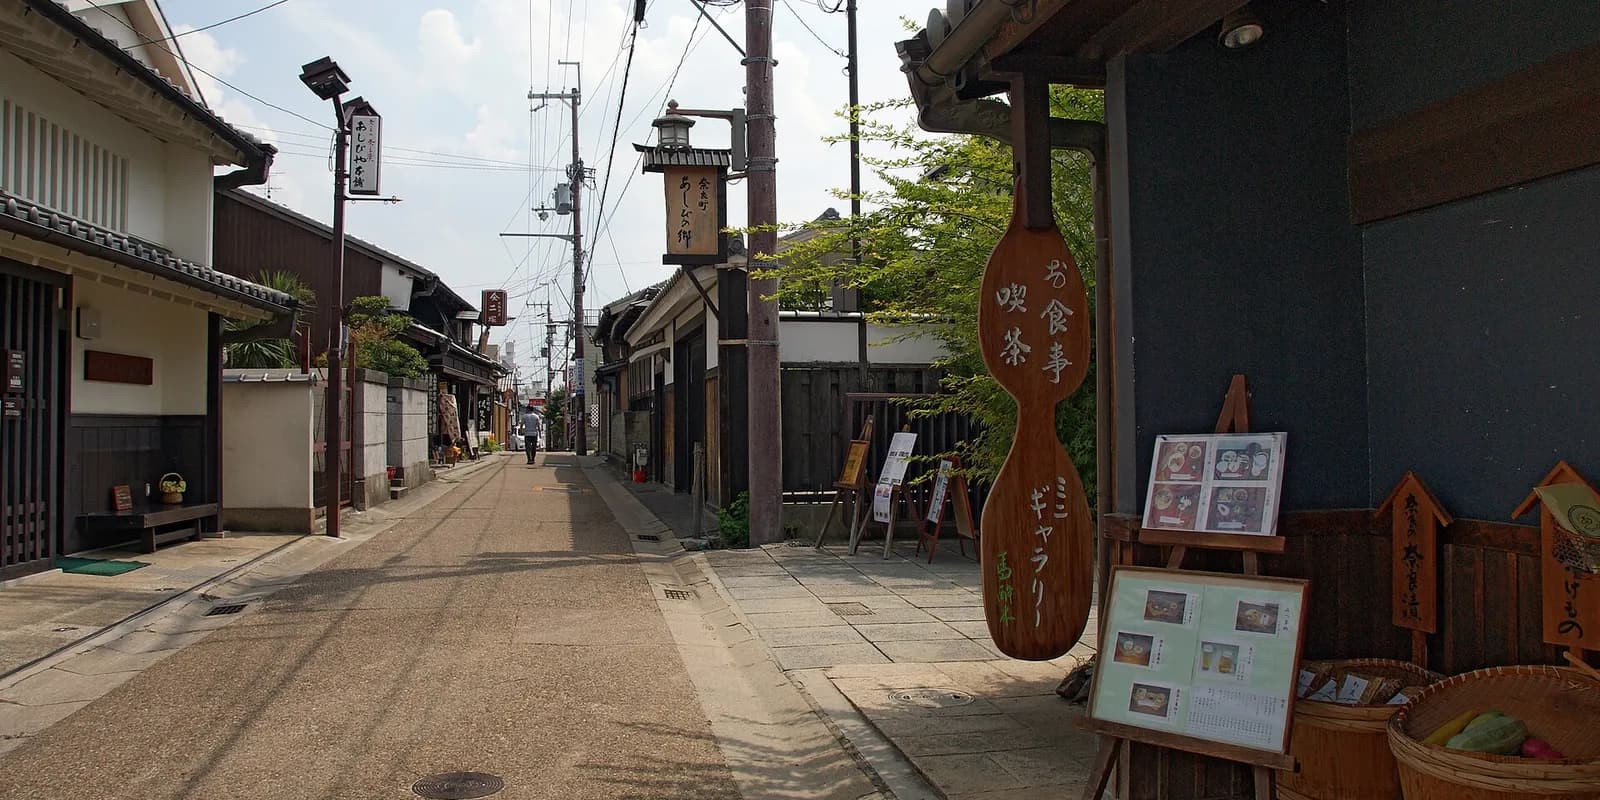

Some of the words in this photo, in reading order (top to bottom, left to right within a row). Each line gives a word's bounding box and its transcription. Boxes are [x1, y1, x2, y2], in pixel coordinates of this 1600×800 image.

[677, 175, 692, 249] あしびの郷
[698, 176, 710, 211] 奈良町
[995, 282, 1032, 366] 喫茶
[1040, 259, 1074, 384] お食事
[1053, 475, 1069, 519] ミニ
[1030, 485, 1054, 628] ギャラリー
